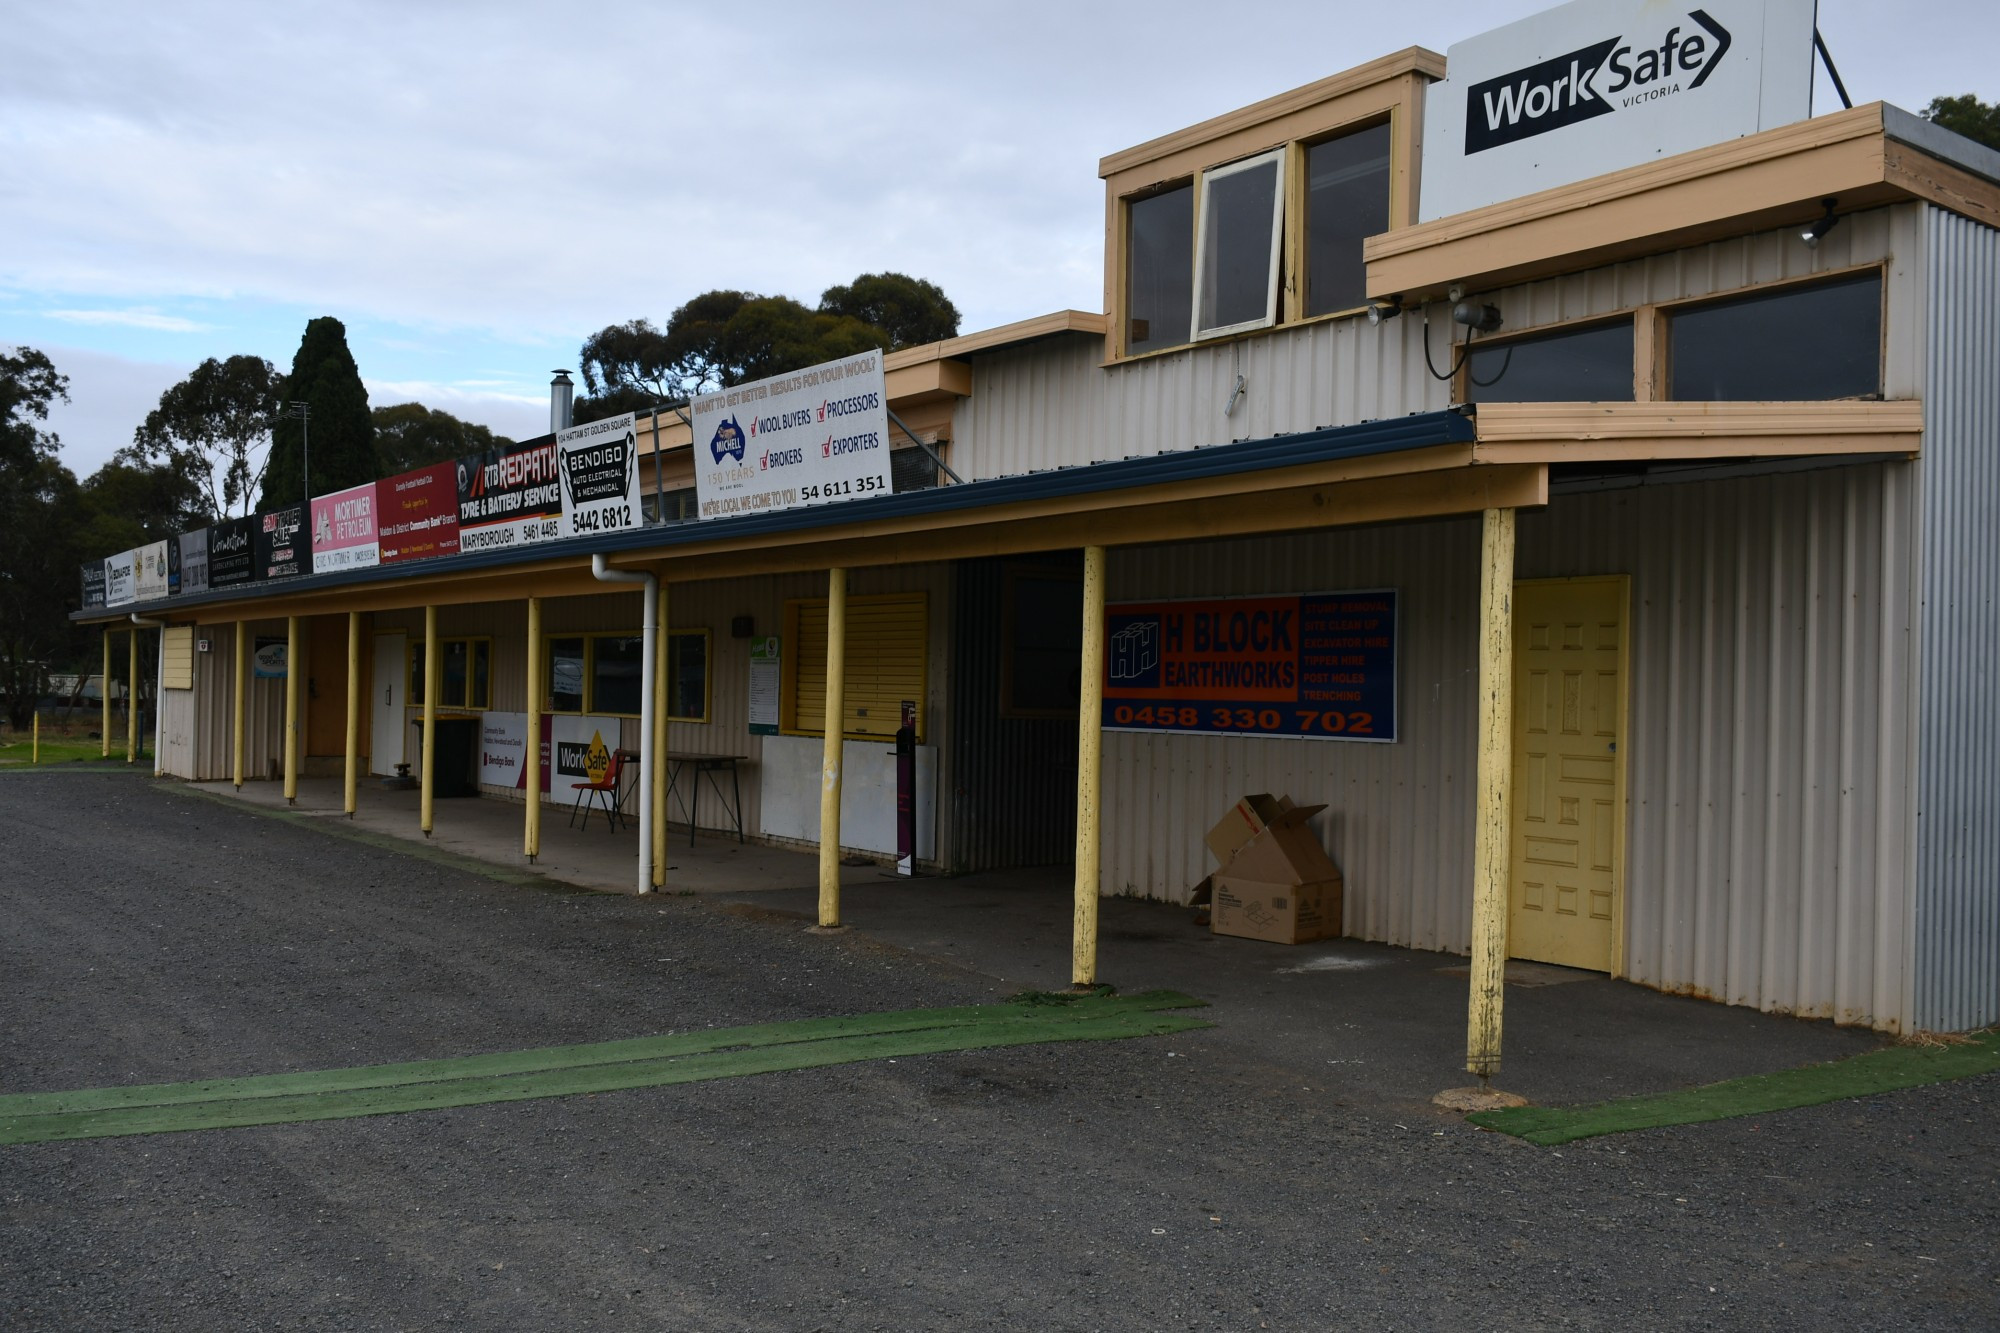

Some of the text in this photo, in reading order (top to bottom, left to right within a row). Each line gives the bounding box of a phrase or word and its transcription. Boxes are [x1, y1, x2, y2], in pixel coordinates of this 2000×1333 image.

[1623, 83, 1680, 107] VICTORIA
[694, 356, 876, 415] WANT TO GET BETTER RESULTS FOR YOUR WOOL?
[827, 392, 879, 417] PROCESSORS
[558, 417, 631, 443] 104 HATTAM ST GOLDEN SQUARE
[758, 408, 810, 434] WOOL BUYERS
[716, 439, 741, 452] MICHELL
[833, 432, 878, 456] EXPORTERS
[484, 446, 558, 490] RTB REDPATH
[570, 446, 622, 471] BENDIGO
[770, 448, 802, 468] BROKERS
[573, 468, 622, 485] AUTO ELECTRICAL
[708, 466, 754, 485] 150 YEARS
[802, 475, 885, 500] 54 611 351
[461, 483, 558, 520] TYRE & BATTERY SERVICE
[577, 482, 619, 497] & MECHANICAL
[335, 496, 370, 522] MORTIMER
[702, 488, 796, 516] WE'RE LOCAL WE COME TO YOU
[337, 516, 372, 540] PETROLEUM
[442, 513, 456, 525] Branch
[573, 505, 631, 533] 5442 6812
[462, 528, 514, 550] MARYBOROUGH
[523, 524, 539, 540] 5461
[541, 521, 558, 538] 4485
[1305, 601, 1390, 614] STUMP REMOVAL
[1166, 609, 1293, 653] H BLOCK
[1305, 620, 1379, 632] SITE CLEAN UP
[1304, 637, 1390, 648] EXCAVATOR HIRE
[1304, 656, 1366, 666] TIPPER HIRE
[1164, 660, 1295, 688] EARTHWORKS
[1304, 673, 1366, 684] POST HOLES
[1303, 690, 1362, 702] TRENCHING
[1114, 704, 1374, 734] 0458 330 702
[488, 755, 515, 768] Bendigo Bank
